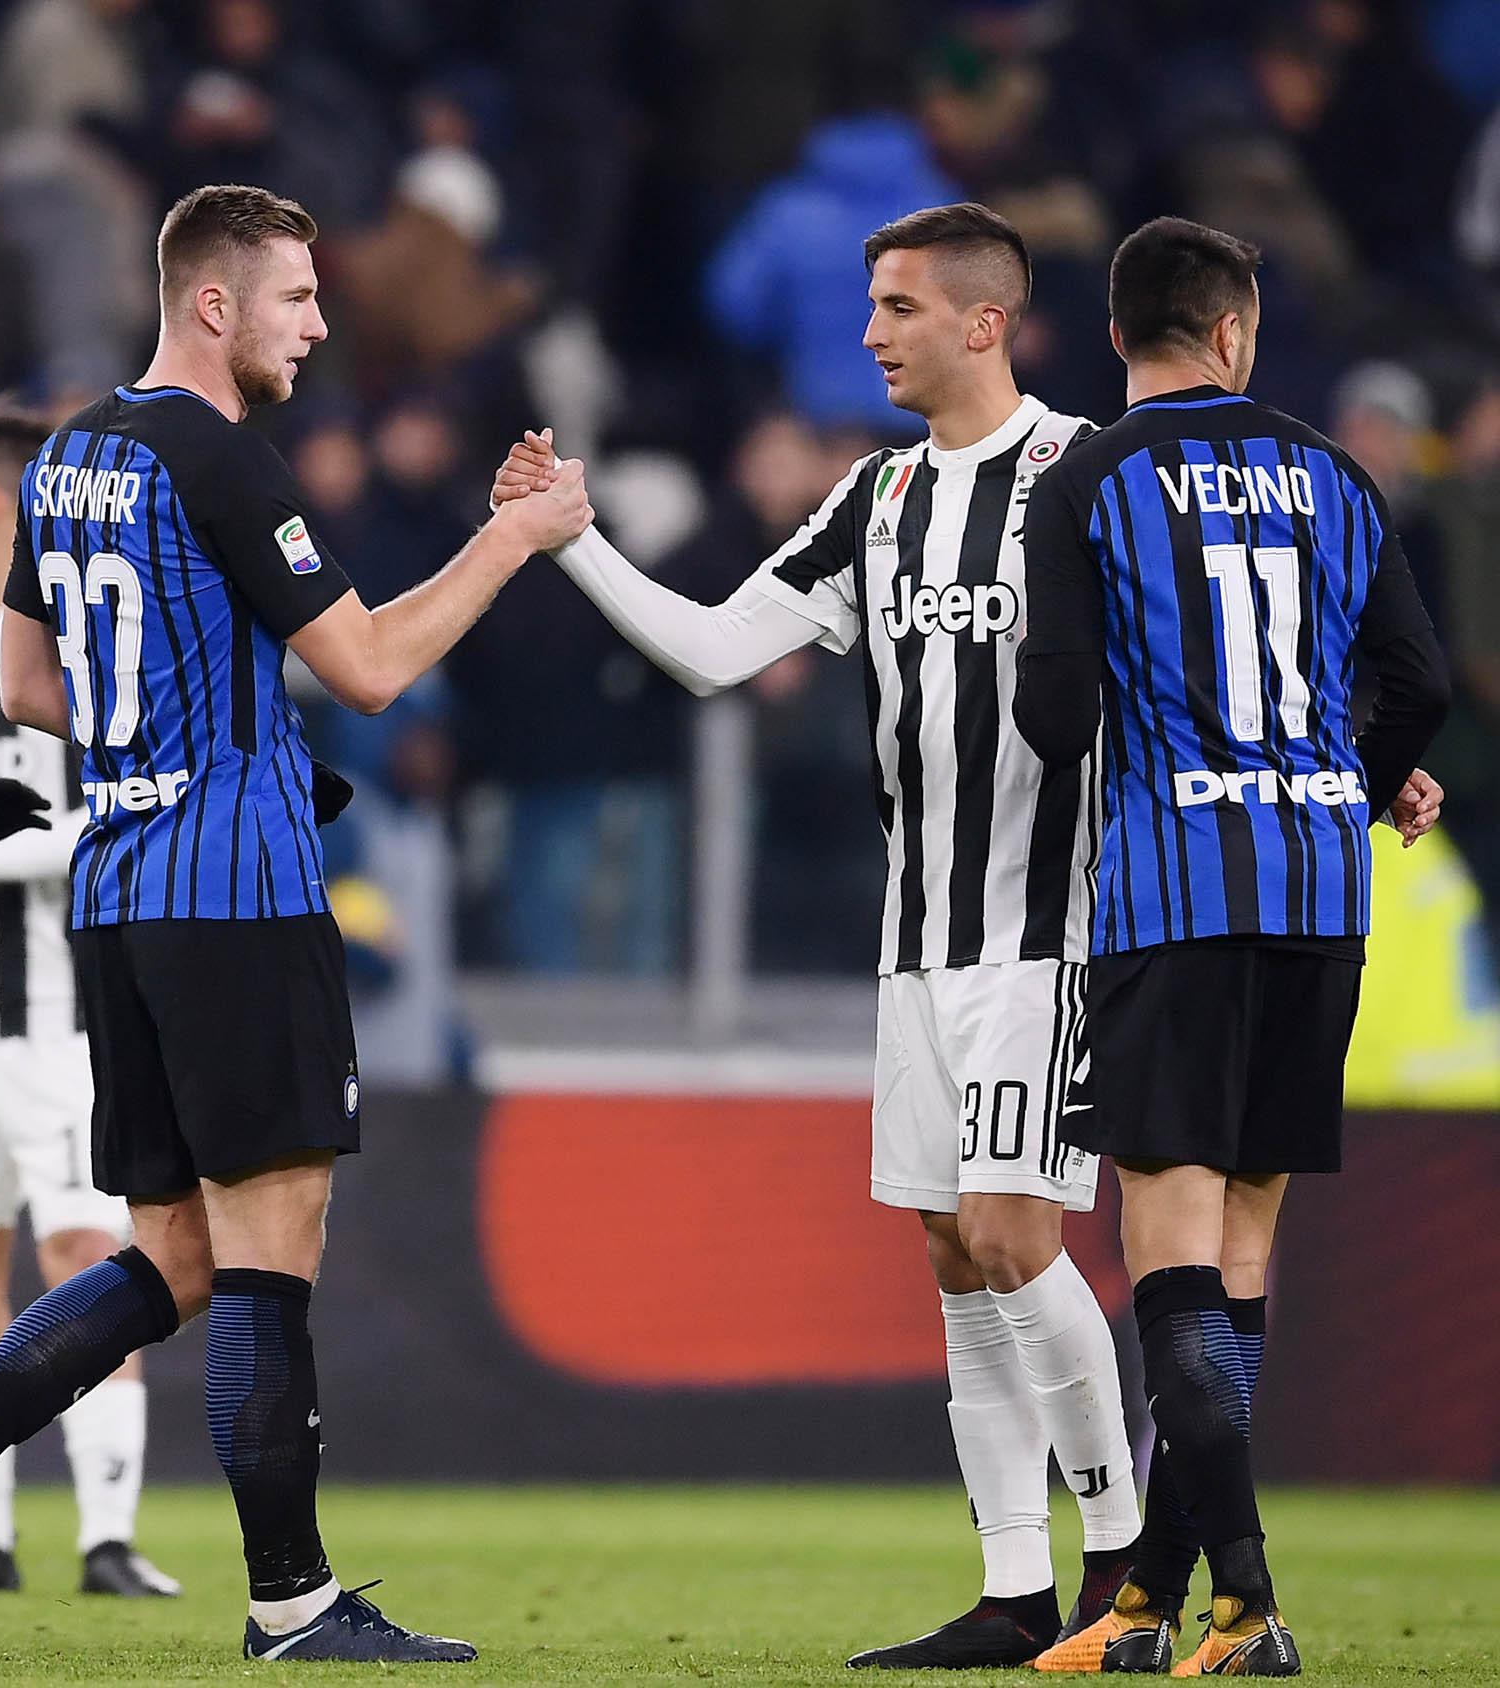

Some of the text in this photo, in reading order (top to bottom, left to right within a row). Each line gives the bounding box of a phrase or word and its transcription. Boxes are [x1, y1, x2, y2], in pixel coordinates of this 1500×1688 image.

[1156, 463, 1315, 515] VECINO
[866, 536, 896, 547] adidas
[881, 574, 1019, 644] Jeep
[1202, 543, 1311, 742] 11
[38, 551, 144, 747] 37
[961, 1079, 1028, 1162] 30
